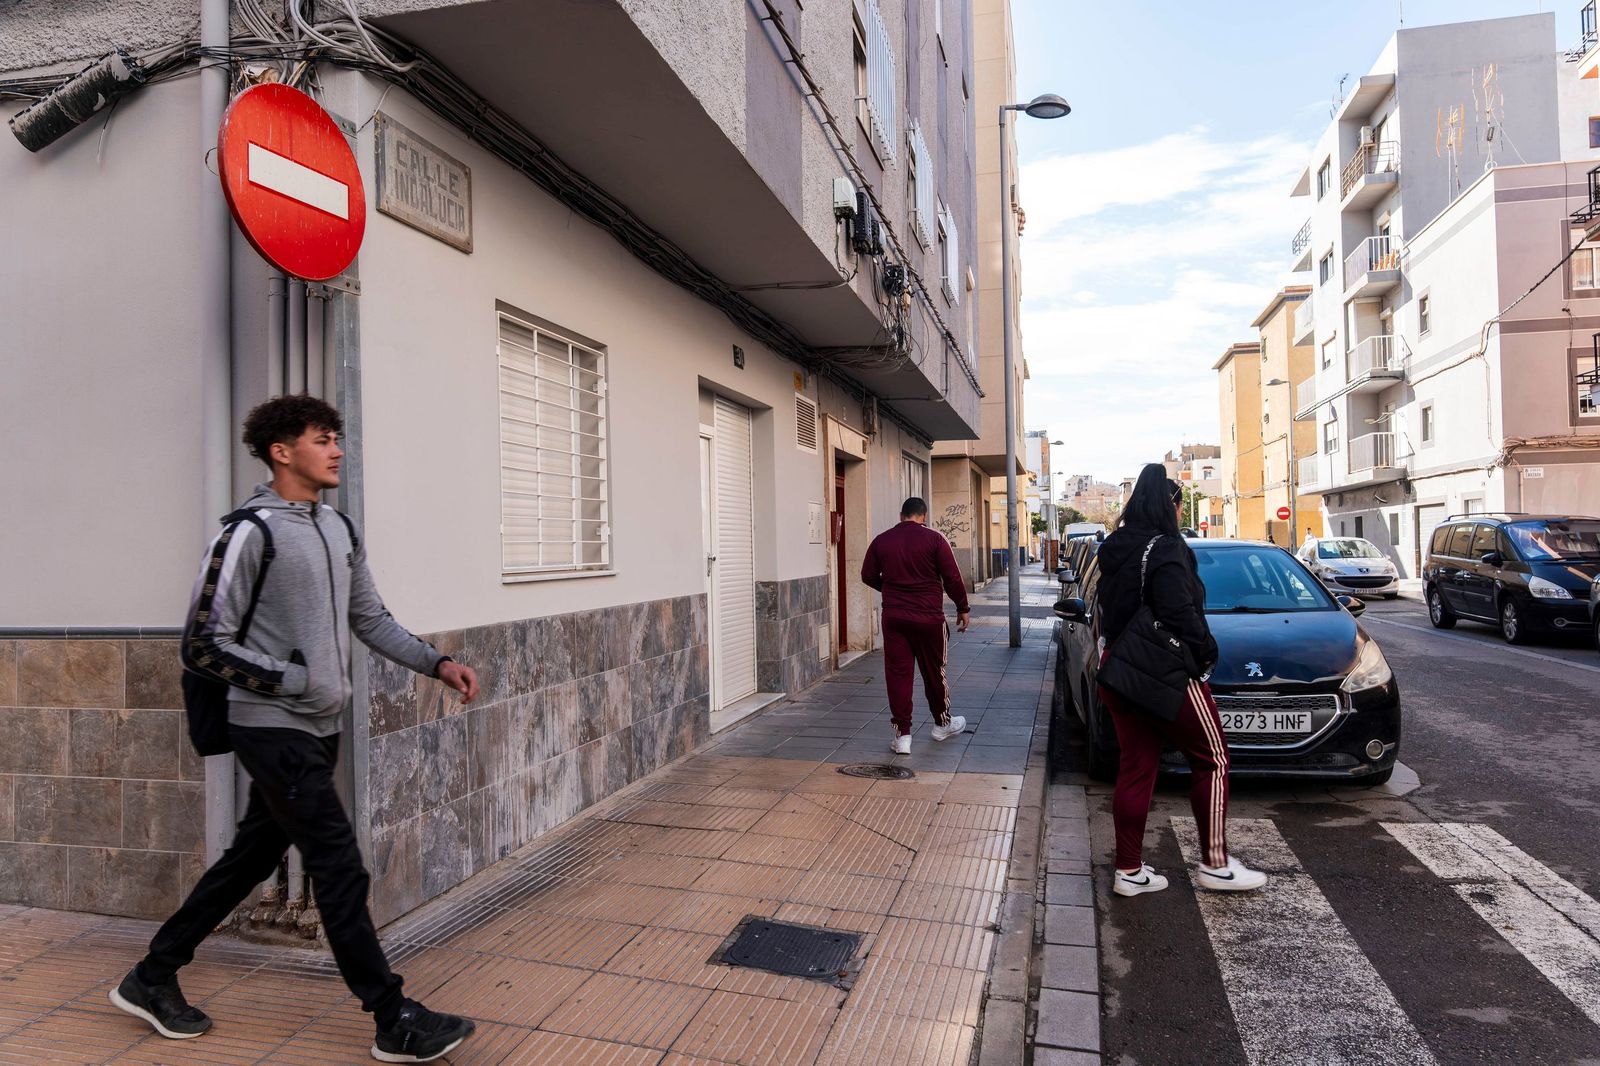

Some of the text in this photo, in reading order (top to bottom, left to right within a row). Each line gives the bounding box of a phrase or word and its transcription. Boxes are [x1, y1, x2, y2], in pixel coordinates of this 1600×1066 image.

[396, 139, 459, 198] CALLE
[1169, 637, 1180, 648] FILA
[1222, 713, 1307, 730] 2873 HNF
